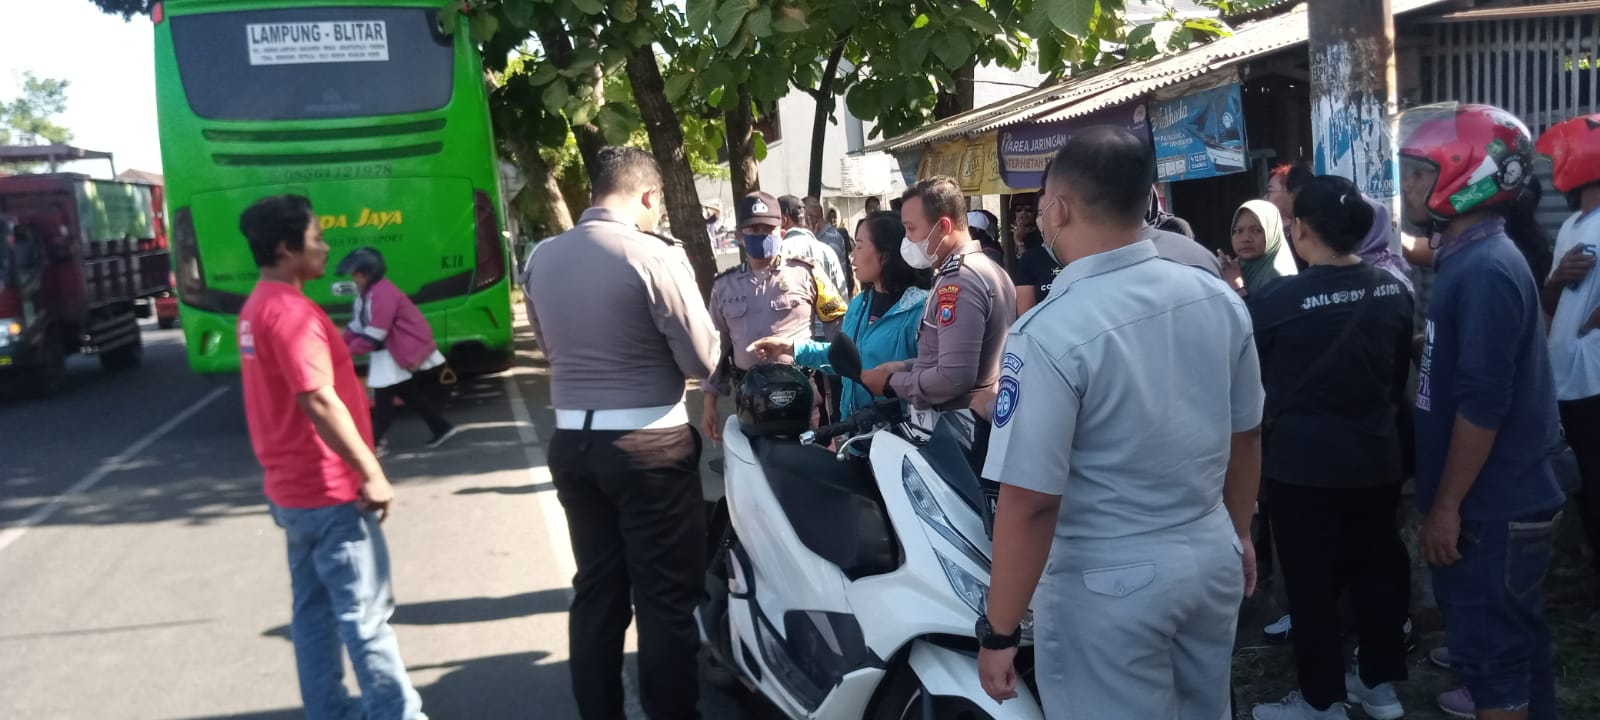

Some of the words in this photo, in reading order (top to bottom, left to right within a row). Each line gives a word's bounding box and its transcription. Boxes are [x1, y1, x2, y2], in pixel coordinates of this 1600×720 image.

[251, 24, 320, 44] LAMPUNG
[334, 23, 384, 41] BLITAR
[1007, 140, 1029, 153] AREA
[1030, 133, 1067, 152] JARINGAN
